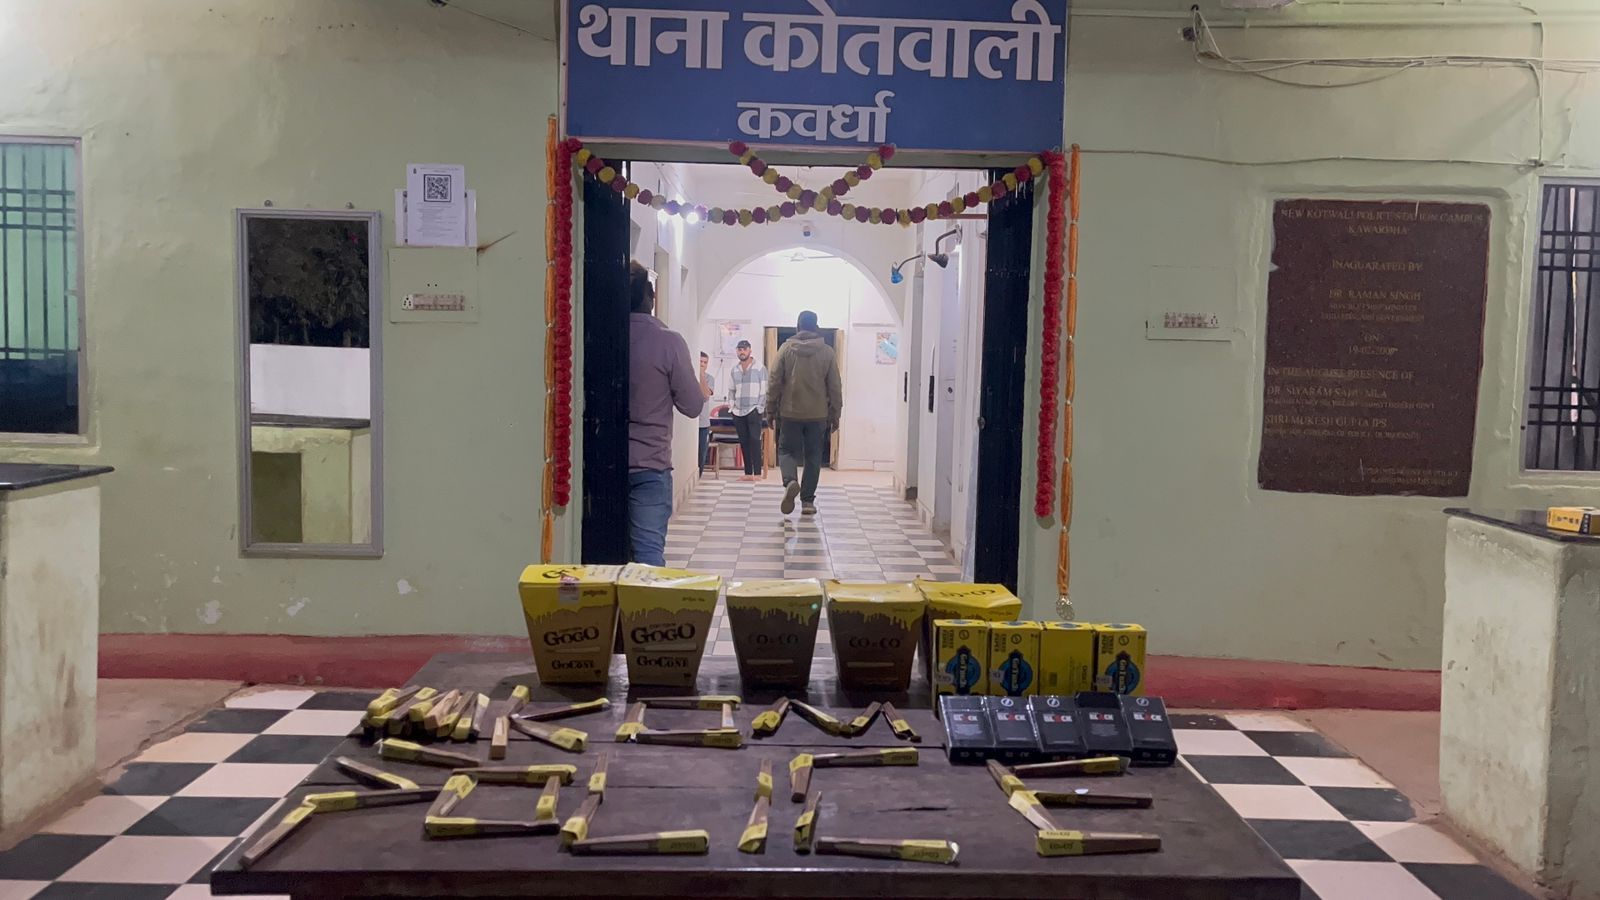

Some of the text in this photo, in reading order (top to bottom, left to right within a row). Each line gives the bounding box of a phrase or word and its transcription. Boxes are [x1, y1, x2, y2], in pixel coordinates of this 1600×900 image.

[576, 0, 1062, 82] थाना कोतवाली
[736, 89, 896, 143] कवर्धा
[1390, 291, 1422, 300] SINGH
